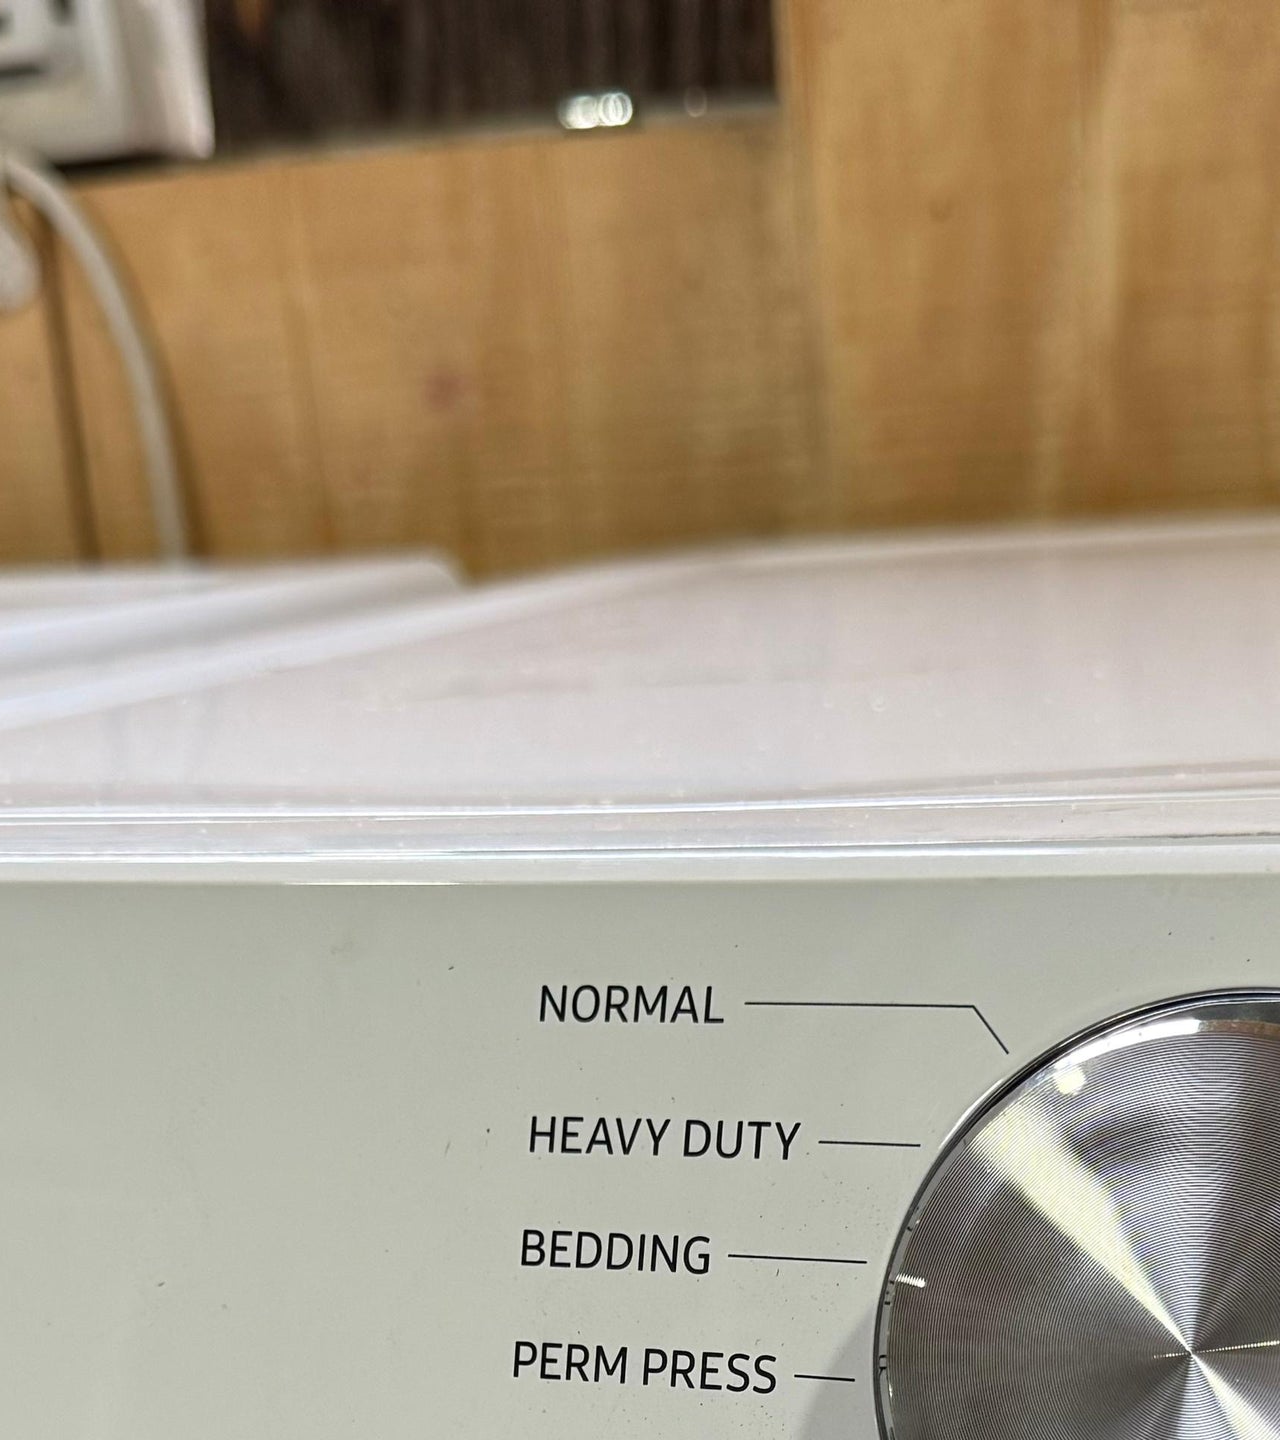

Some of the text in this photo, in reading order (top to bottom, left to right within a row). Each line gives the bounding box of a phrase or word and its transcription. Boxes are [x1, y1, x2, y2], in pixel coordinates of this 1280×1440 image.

[539, 984, 725, 1025] NORMAL
[528, 1115, 802, 1161] HEAVY DUTY
[520, 1229, 711, 1275] BEDDING
[513, 1340, 778, 1395] PERM PRESS
